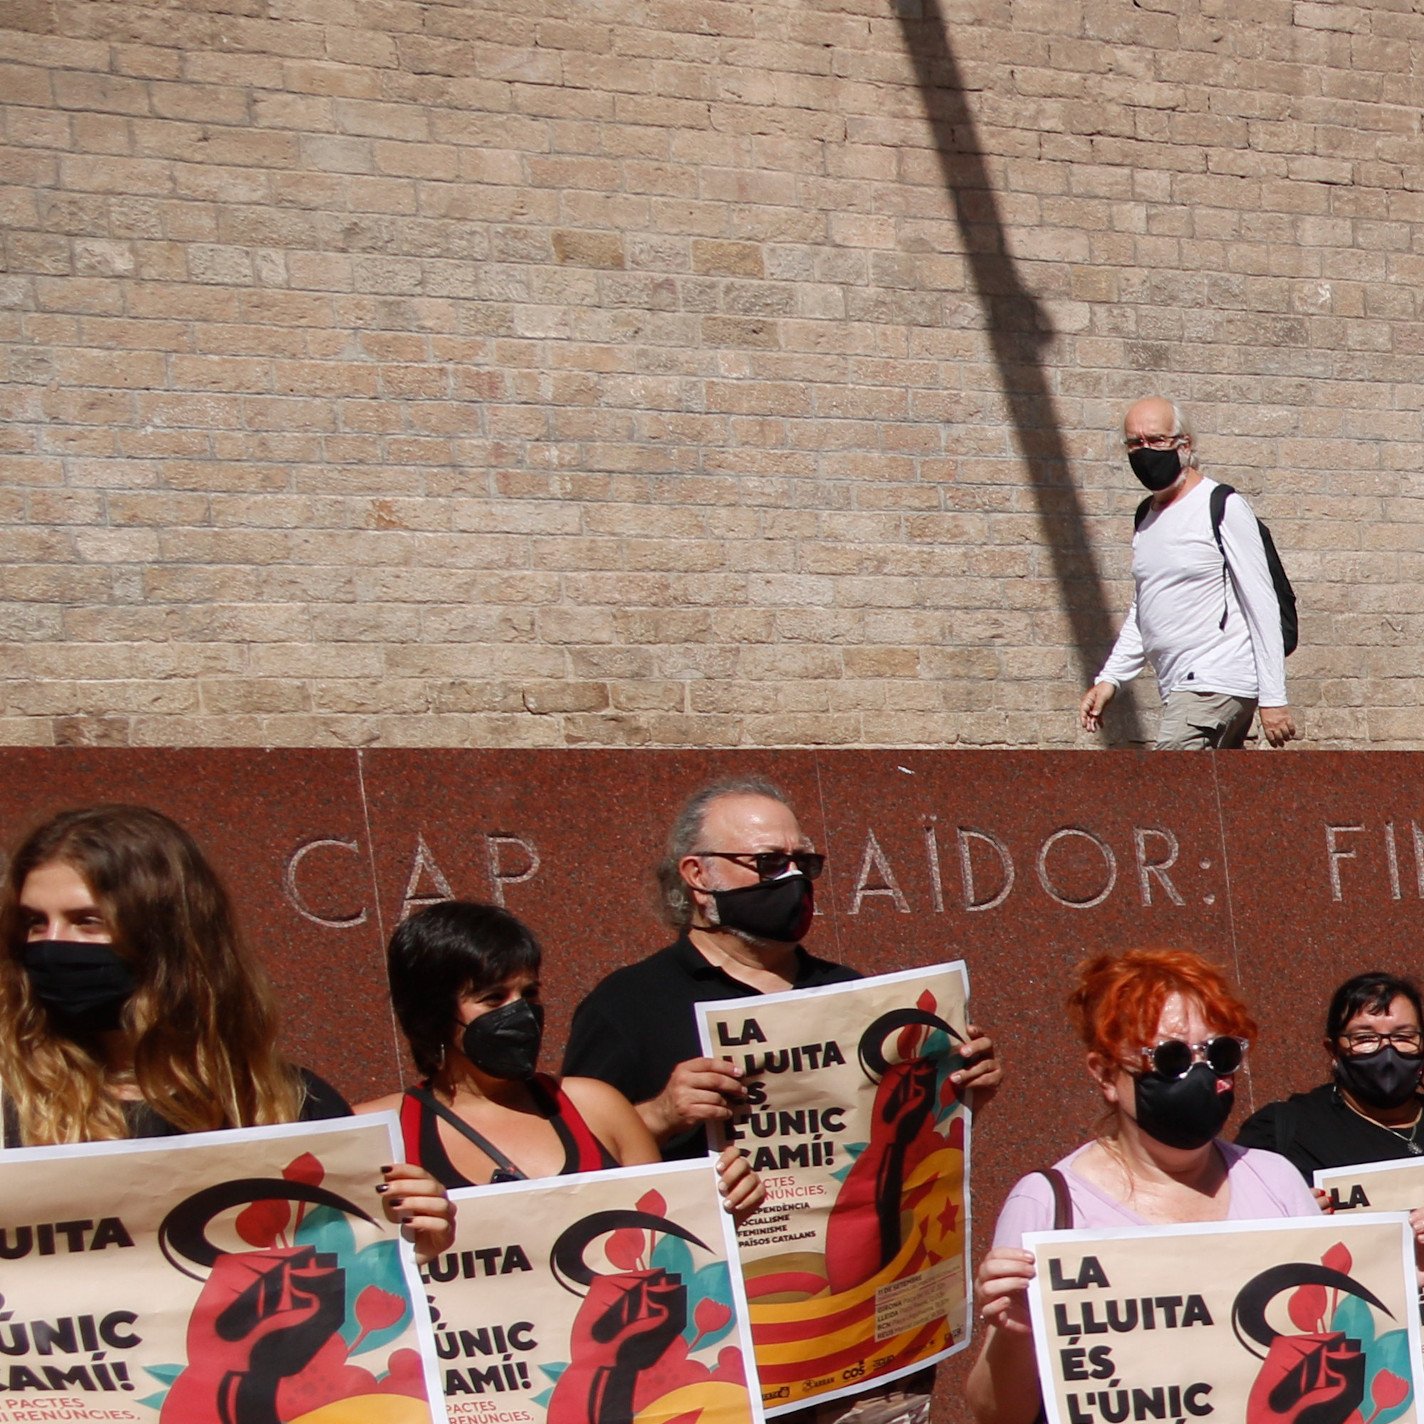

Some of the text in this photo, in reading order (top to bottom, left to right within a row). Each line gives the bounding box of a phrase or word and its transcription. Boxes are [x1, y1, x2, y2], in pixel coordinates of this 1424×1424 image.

[284, 832, 541, 930] CAP
[803, 812, 1214, 915] AÏDOR:
[717, 1018, 767, 1046] LA
[1330, 1184, 1371, 1210] LA
[0, 1217, 135, 1260] UITA
[737, 1225, 788, 1238] FEMINISME
[738, 1230, 816, 1248] PAÏSOS CATALANS
[419, 1245, 533, 1284] UITA
[1047, 1255, 1111, 1291] LA
[0, 1310, 143, 1356] ÚNIC
[1053, 1294, 1214, 1337] LLUITA
[436, 1321, 538, 1360] ÚNIC
[1060, 1336, 1116, 1381] ÉS
[444, 1353, 532, 1396] AMÍ!
[6, 1397, 85, 1410] PACTES
